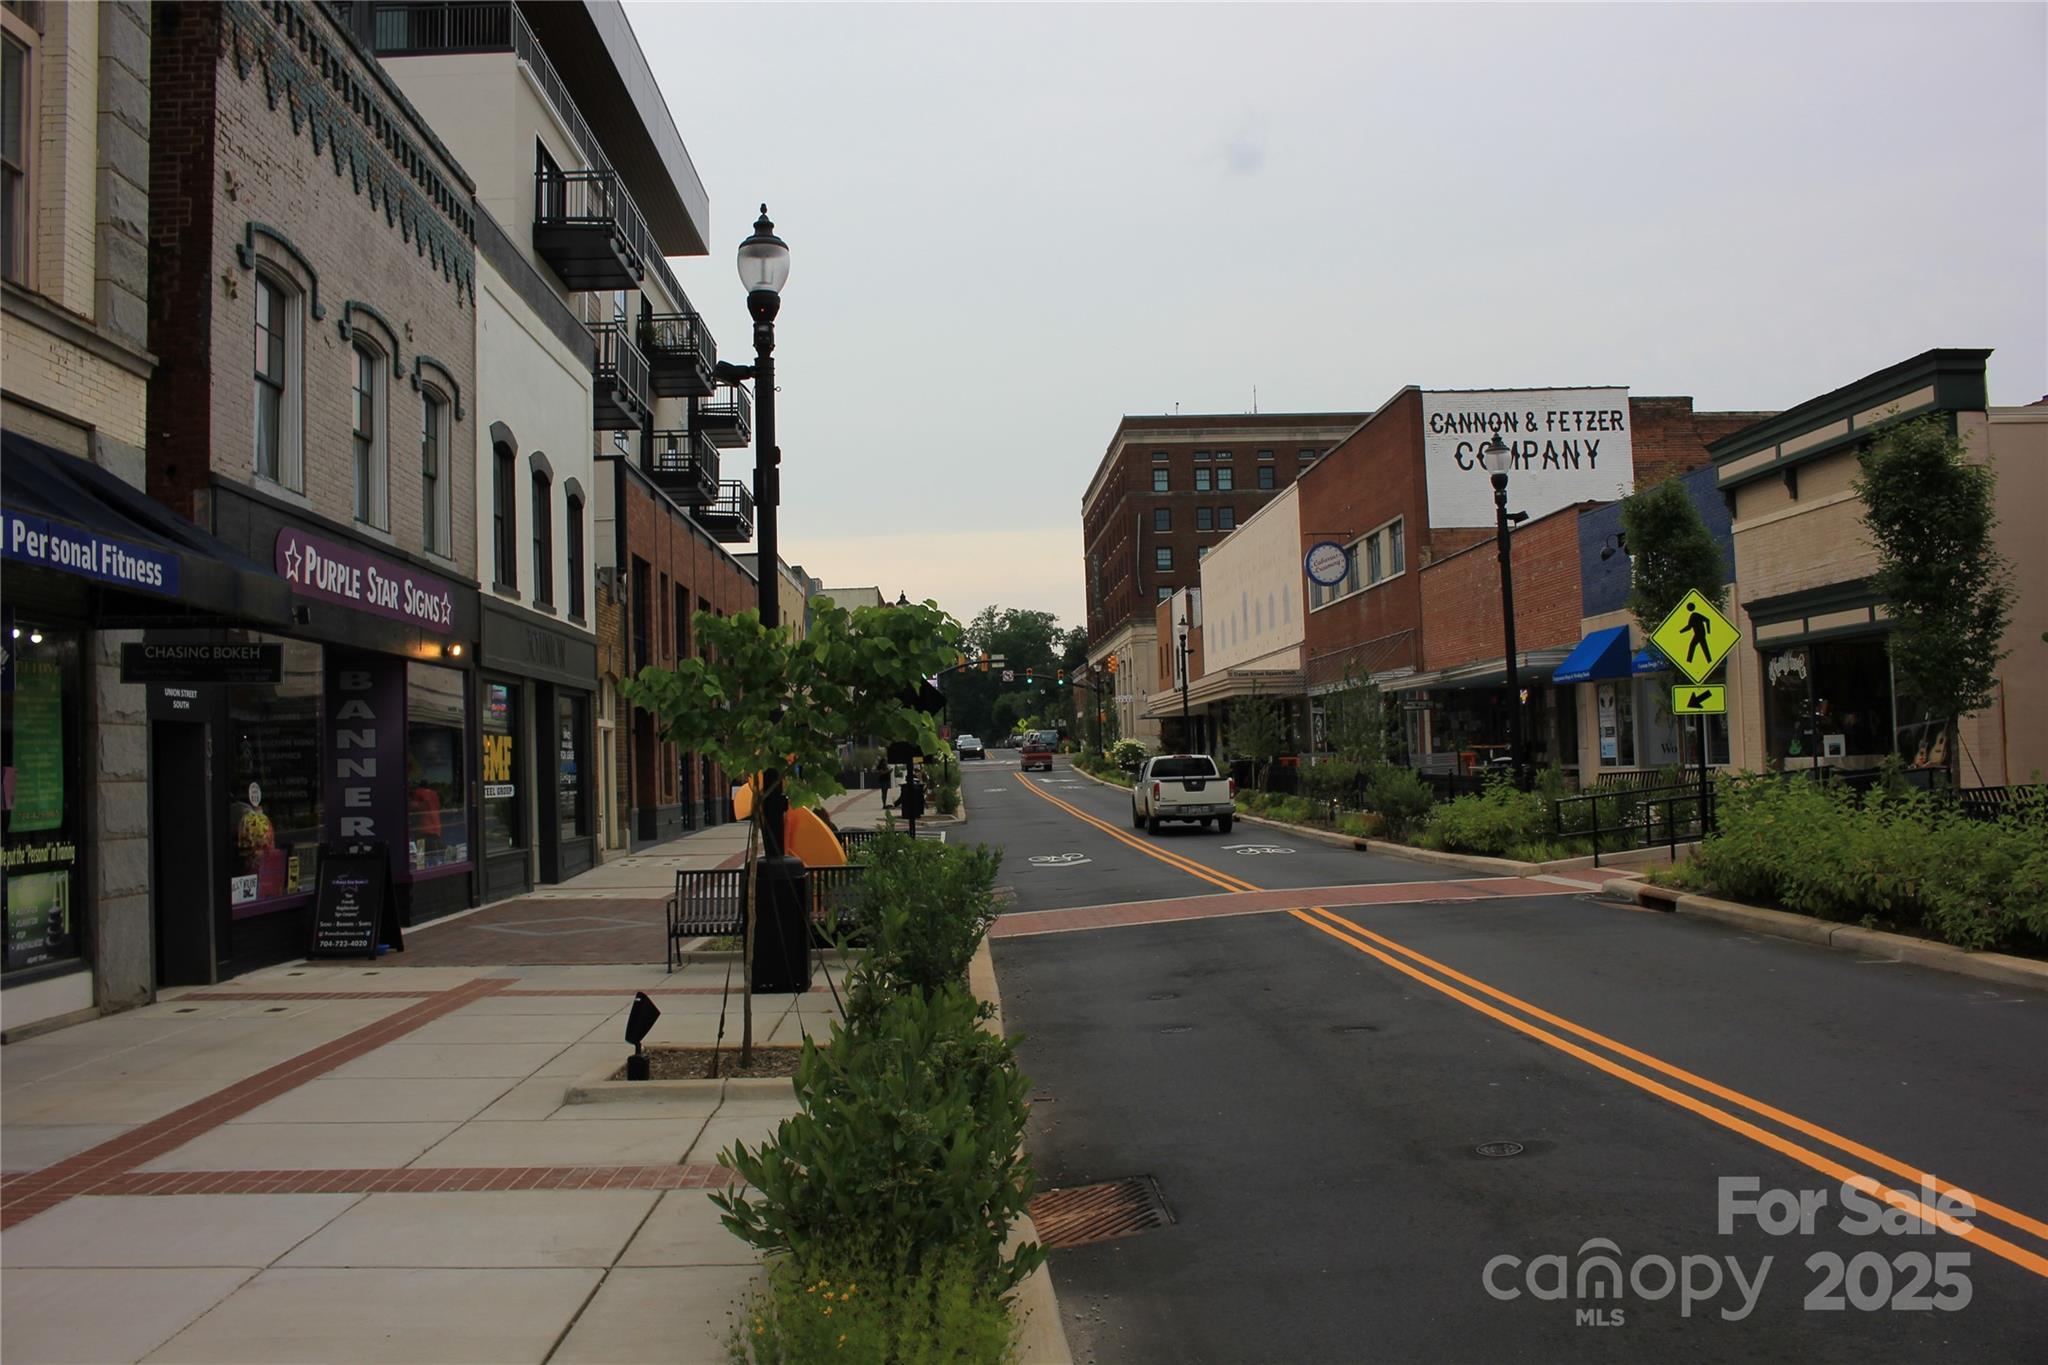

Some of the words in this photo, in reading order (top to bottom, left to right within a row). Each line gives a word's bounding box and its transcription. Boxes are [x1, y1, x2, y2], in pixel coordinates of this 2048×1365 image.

[1429, 411, 1518, 433] CANNON
[1525, 411, 1538, 432] &
[1546, 410, 1624, 431] FETZER
[12, 518, 98, 573] Personal
[102, 543, 163, 587] Fitness
[304, 544, 361, 600] PURPLE
[367, 566, 399, 610] STAR
[403, 579, 440, 623] SIGNS
[145, 645, 210, 660] CHASING
[213, 645, 261, 660] BOKEH
[164, 687, 181, 698] UNION
[173, 700, 190, 710] SOUTH
